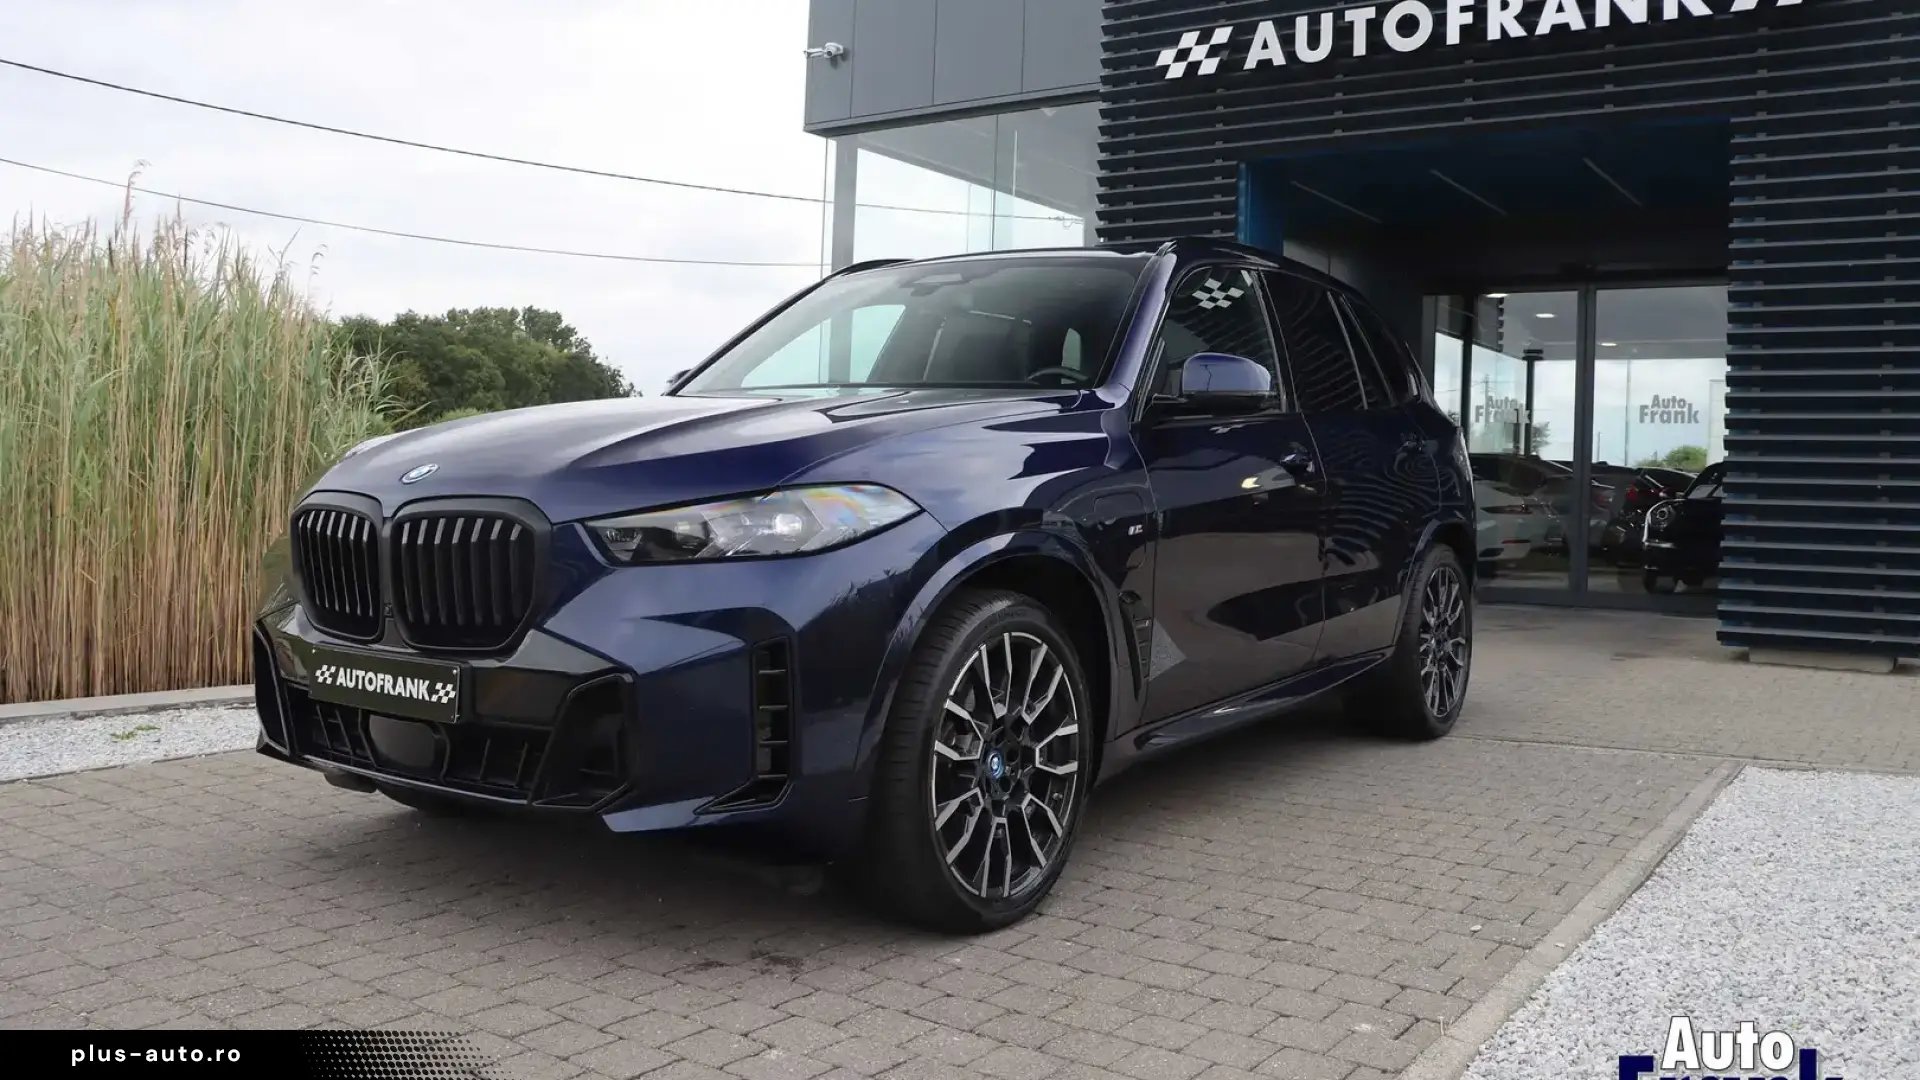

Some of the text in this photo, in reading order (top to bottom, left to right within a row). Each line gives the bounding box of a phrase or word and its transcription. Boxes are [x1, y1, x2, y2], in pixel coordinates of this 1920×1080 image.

[1650, 394, 1686, 409] Auto
[1639, 403, 1700, 424] Frank
[336, 667, 432, 701] AUTOFRANK
